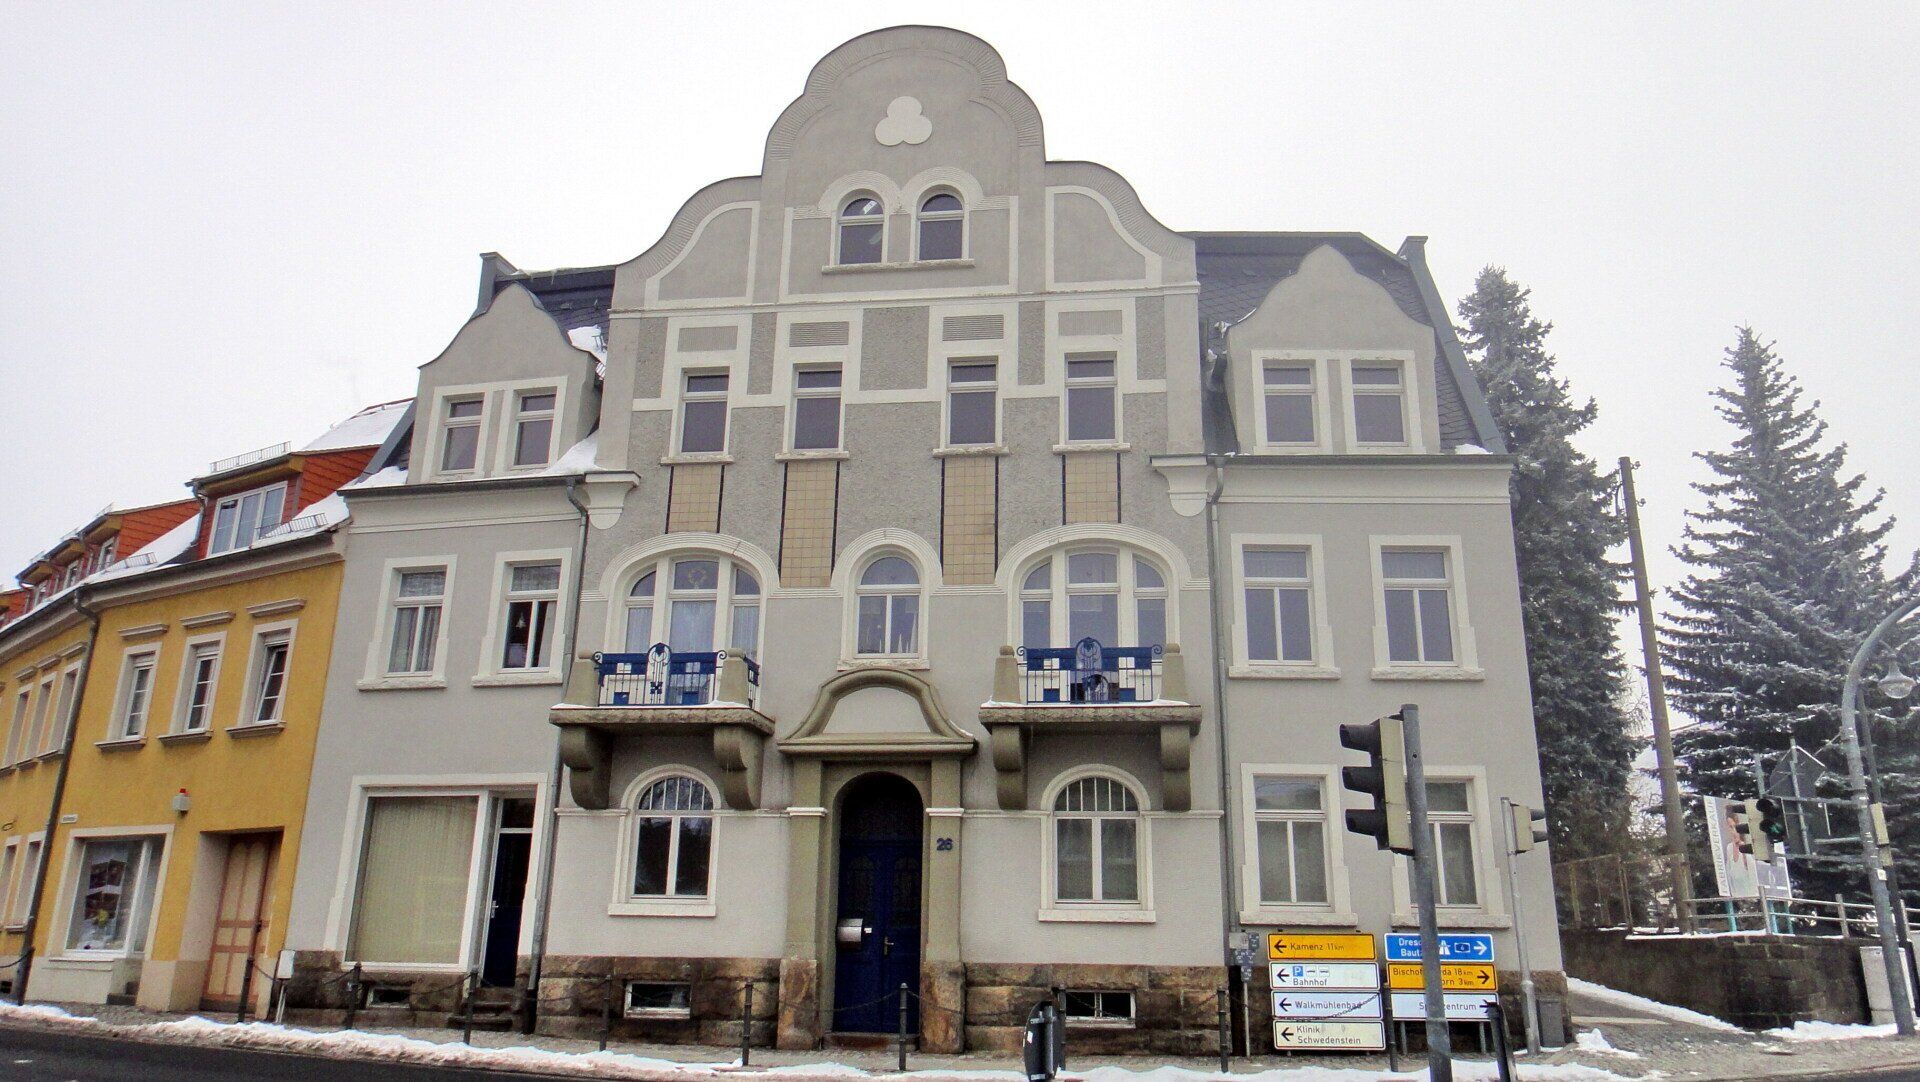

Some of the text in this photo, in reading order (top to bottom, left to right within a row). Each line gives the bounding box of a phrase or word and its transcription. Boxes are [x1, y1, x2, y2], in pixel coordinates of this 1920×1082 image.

[936, 837, 953, 851] 26
[1290, 943, 1324, 951] Kamenz
[1293, 978, 1328, 986] Bahnhof
[1296, 1026, 1320, 1034] Klinik
[1297, 1036, 1361, 1045] Schwedenstein
